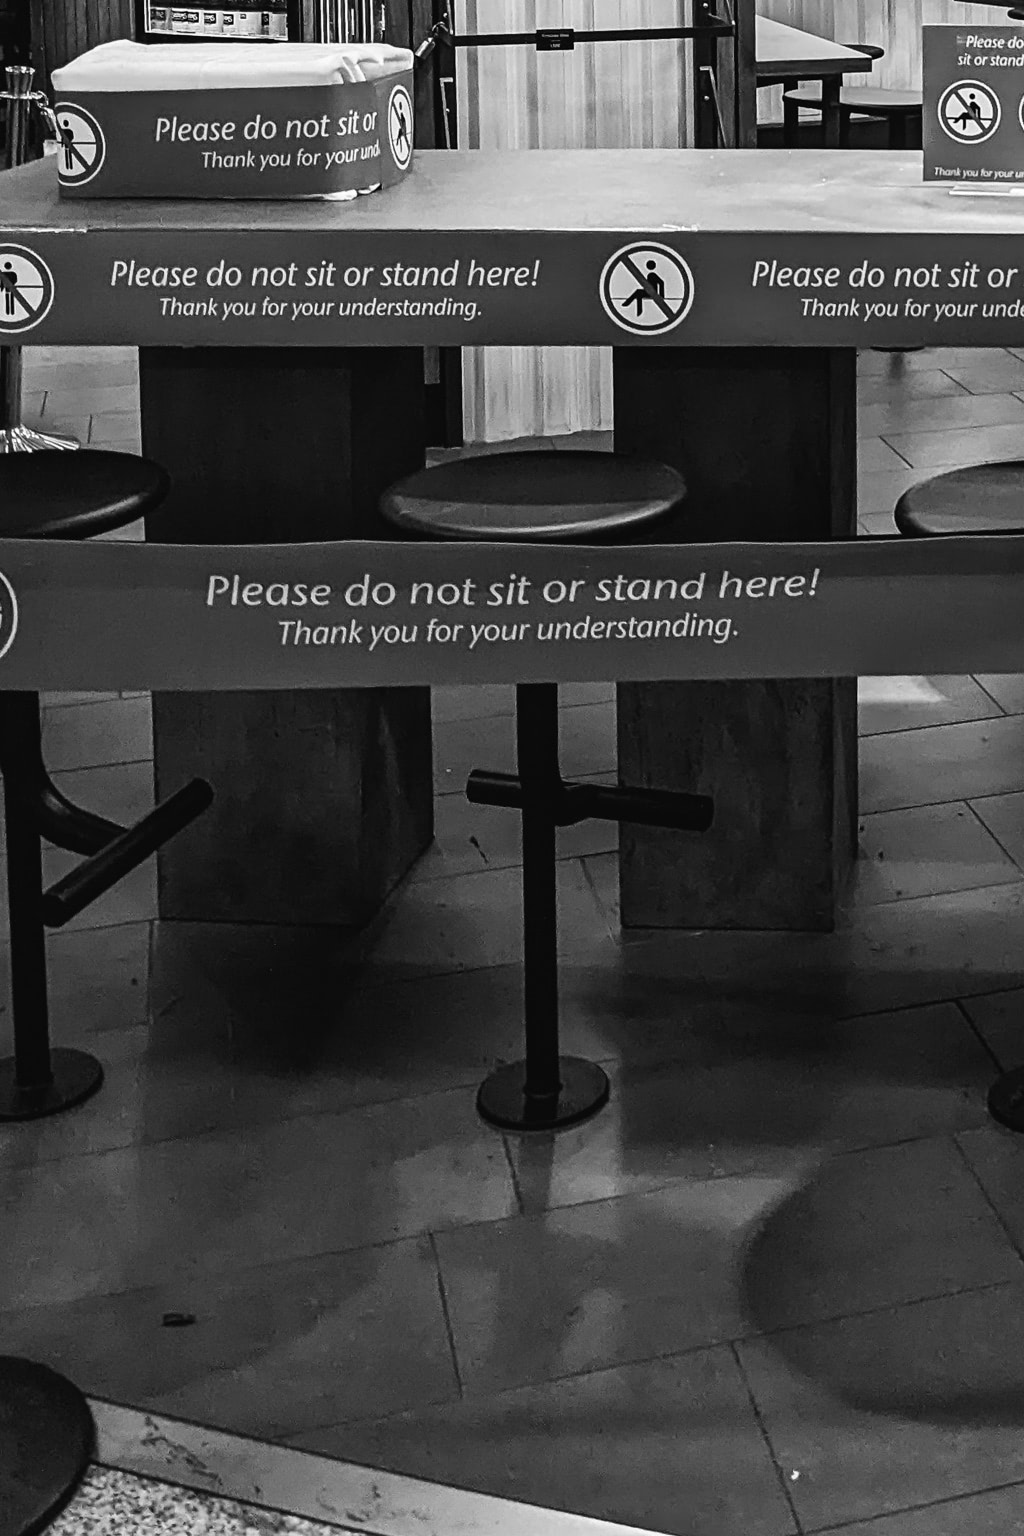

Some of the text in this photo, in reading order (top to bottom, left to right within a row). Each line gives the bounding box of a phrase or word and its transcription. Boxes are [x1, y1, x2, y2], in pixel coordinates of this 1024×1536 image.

[966, 35, 1004, 49] Please
[1008, 36, 1024, 48] do
[958, 55, 971, 66] sit
[974, 56, 988, 66] or
[990, 54, 1024, 67] stand
[155, 110, 378, 142] Please do not sit or
[202, 140, 380, 171] Thank you for your und
[934, 167, 961, 177] Thank
[963, 170, 978, 178] you
[981, 167, 993, 177] for
[994, 170, 1013, 180] your
[110, 259, 540, 287] Please do not sit or stand here!
[752, 259, 841, 288] Please
[848, 260, 885, 288] do
[893, 263, 942, 288] not
[947, 261, 981, 288] sit
[987, 268, 1019, 288] or
[159, 296, 482, 321] Thank you for your understanding.
[800, 298, 860, 317] Thank
[863, 303, 899, 322] you
[904, 298, 931, 317] for
[934, 303, 979, 322] your
[206, 568, 820, 607] Please do not sit or stand here!
[278, 612, 738, 651] Thank you for your understanding.
